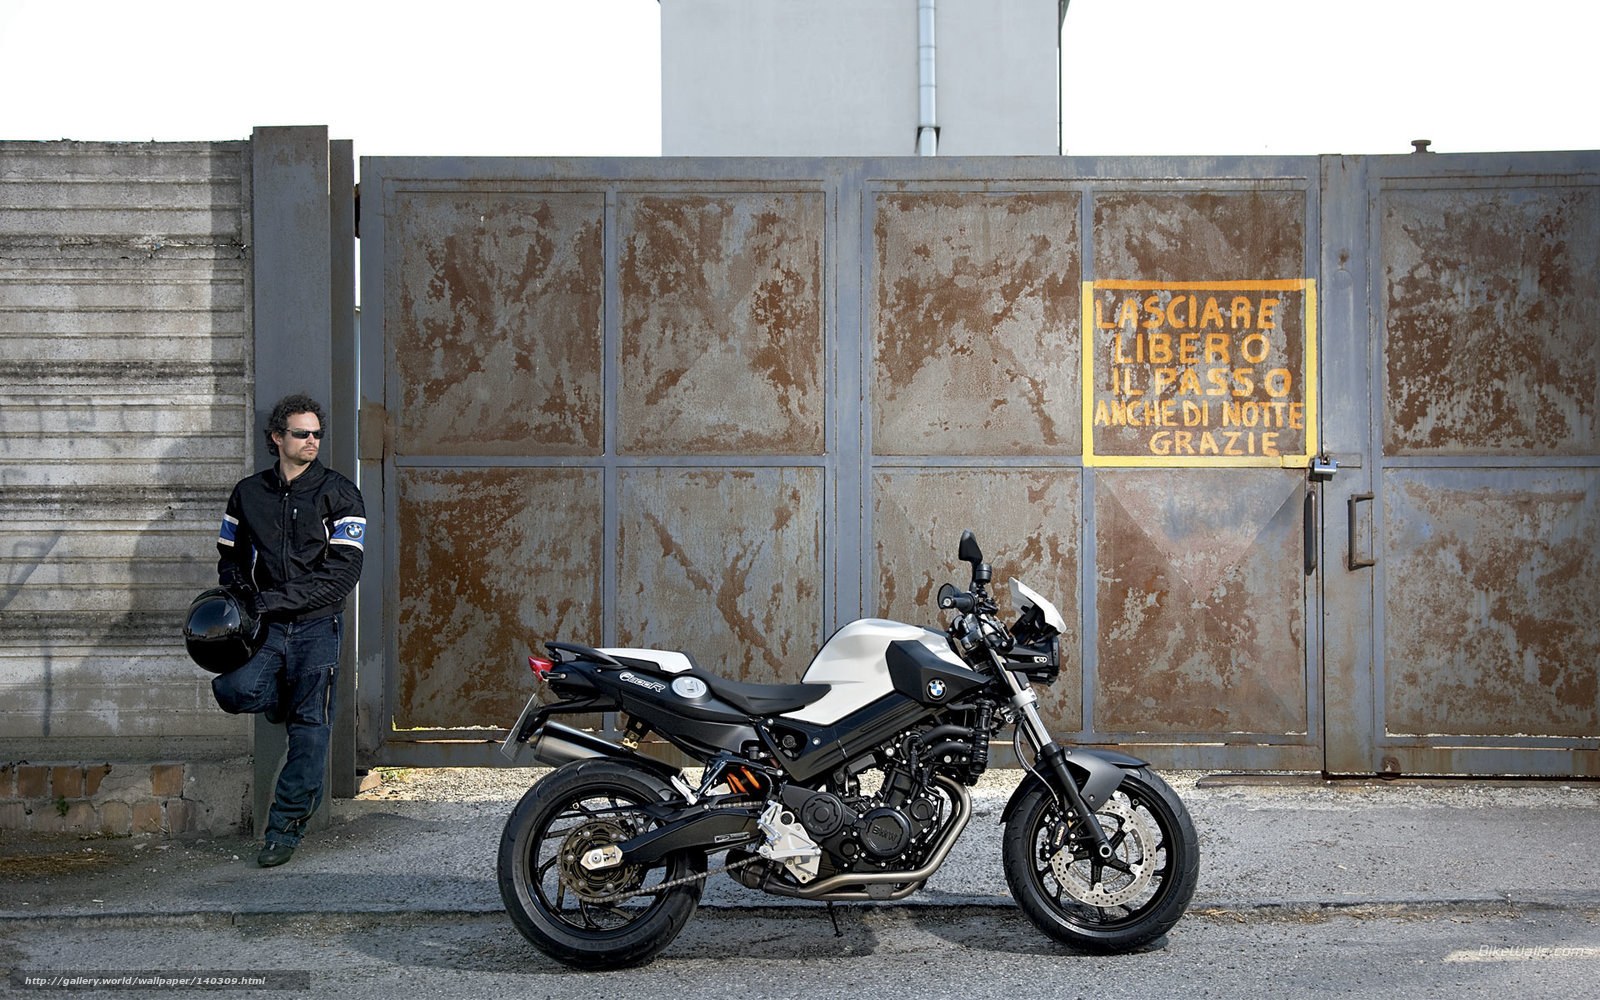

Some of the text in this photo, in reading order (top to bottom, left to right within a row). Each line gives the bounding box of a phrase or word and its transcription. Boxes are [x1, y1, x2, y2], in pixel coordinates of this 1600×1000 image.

[1095, 294, 1280, 329] LASCIARE
[1114, 333, 1270, 364] LIBERO
[1113, 368, 1292, 398] IL PASSO
[1094, 400, 1304, 429] ANCHE DI NOTTE
[1149, 431, 1280, 456] GRAZIE
[872, 824, 898, 842] BMW
